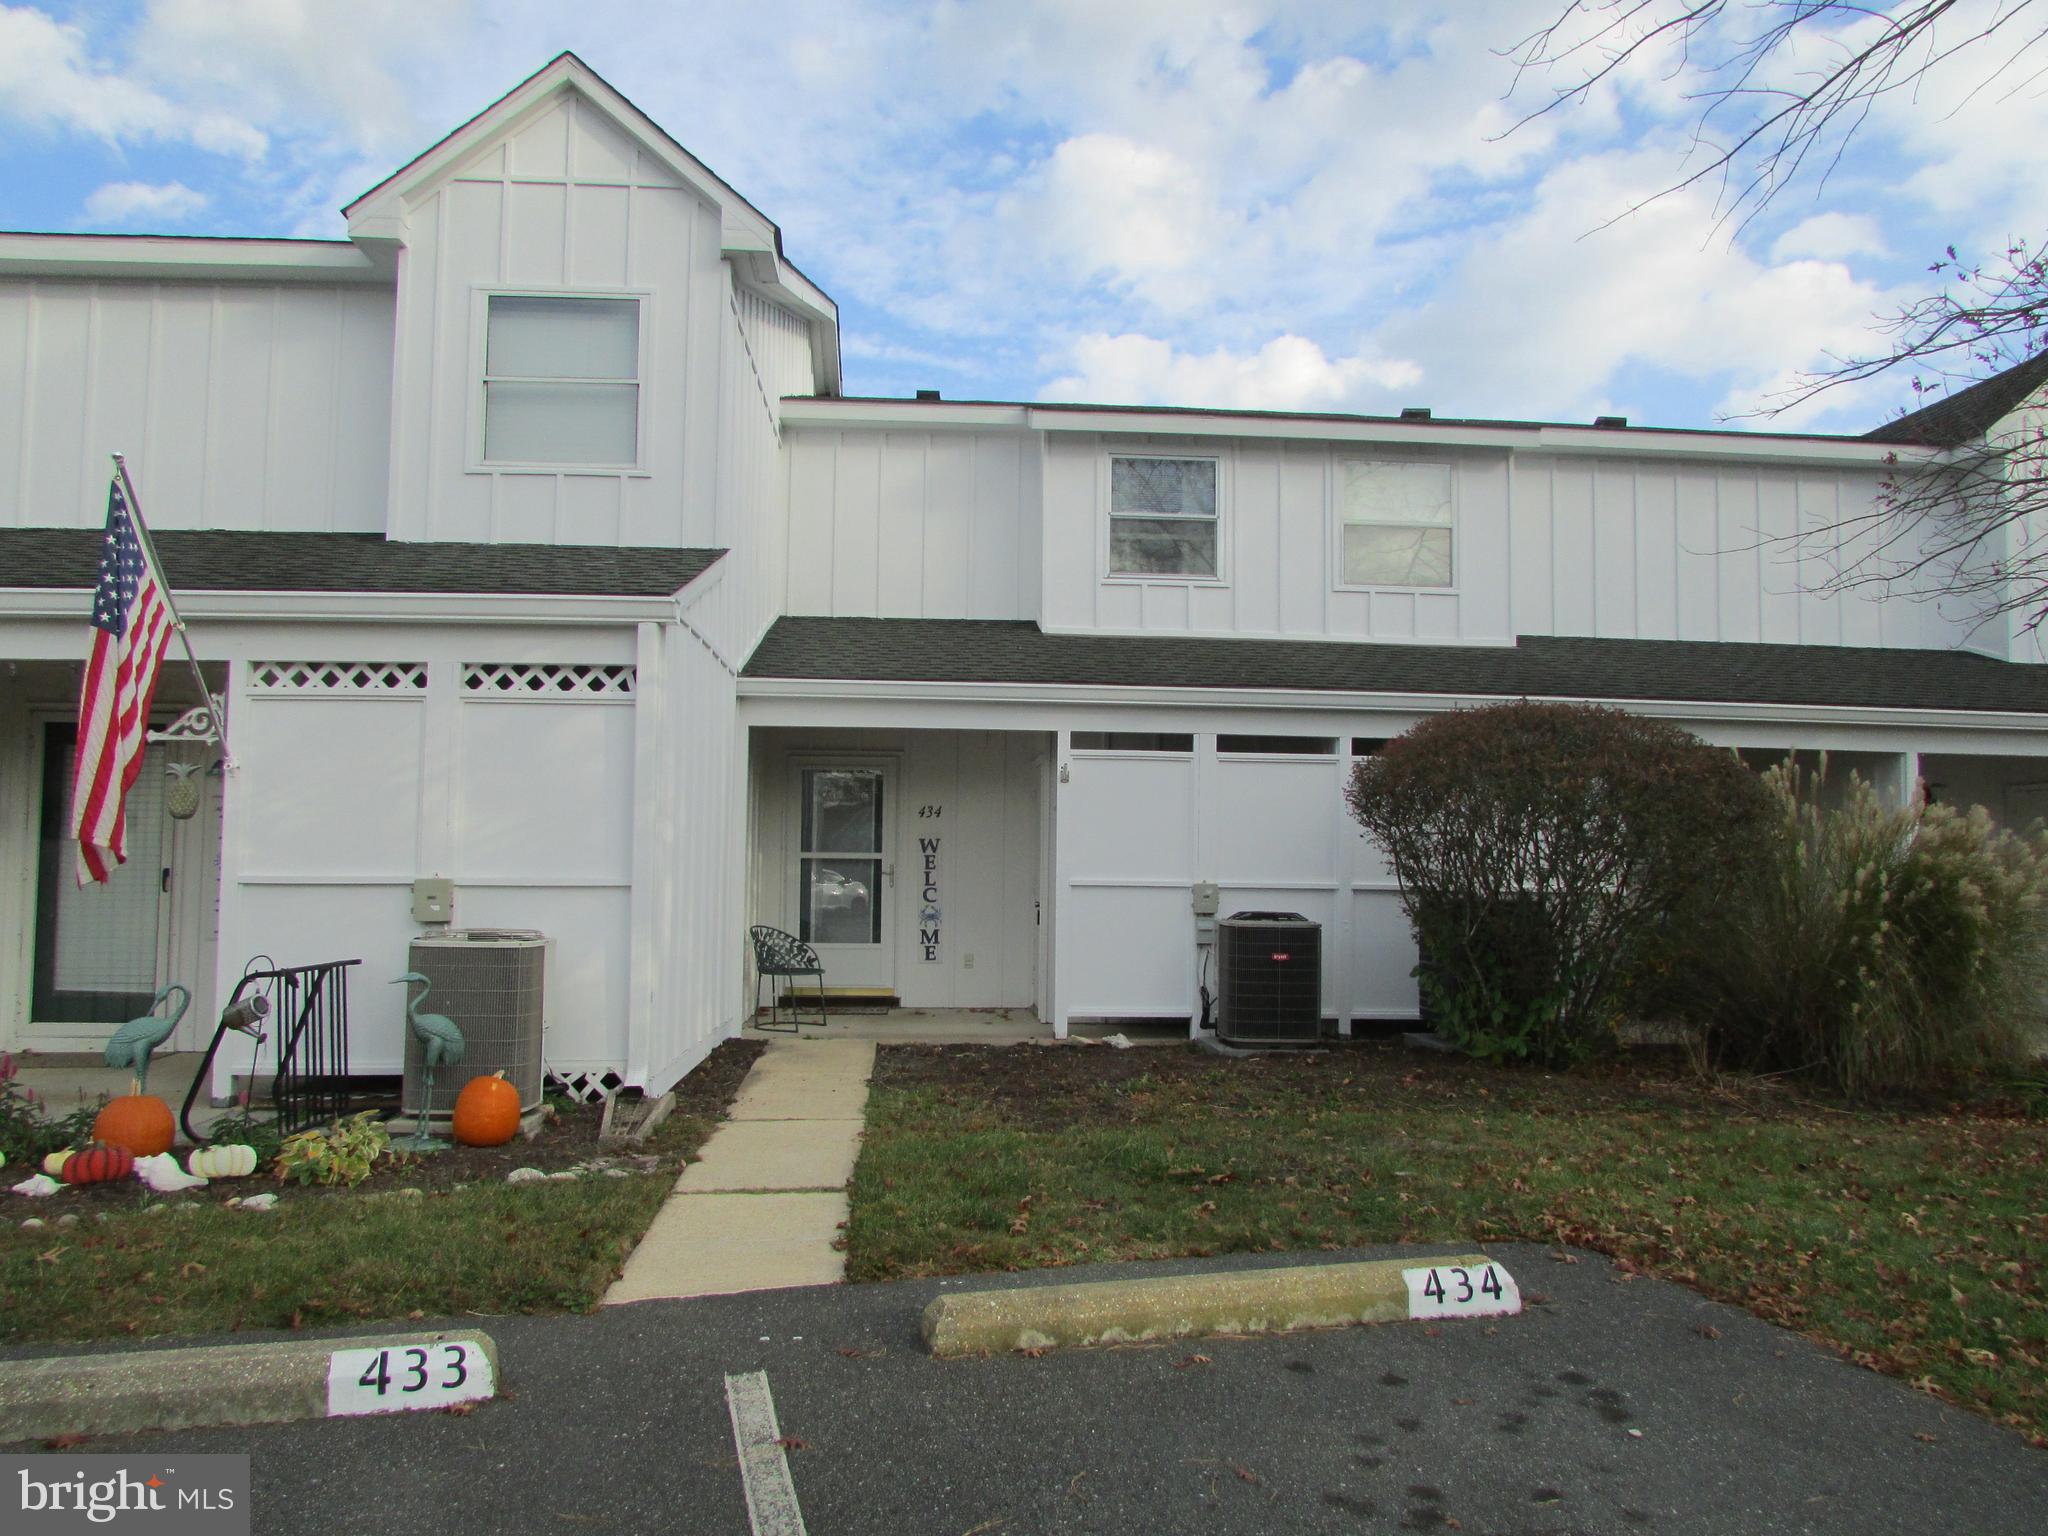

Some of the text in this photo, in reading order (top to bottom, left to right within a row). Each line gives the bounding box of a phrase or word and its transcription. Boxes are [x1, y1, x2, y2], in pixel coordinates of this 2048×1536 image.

[918, 805, 942, 818] 434
[919, 838, 941, 961] WELCME
[1424, 1264, 1502, 1304] 434
[359, 1345, 467, 1395] 433
